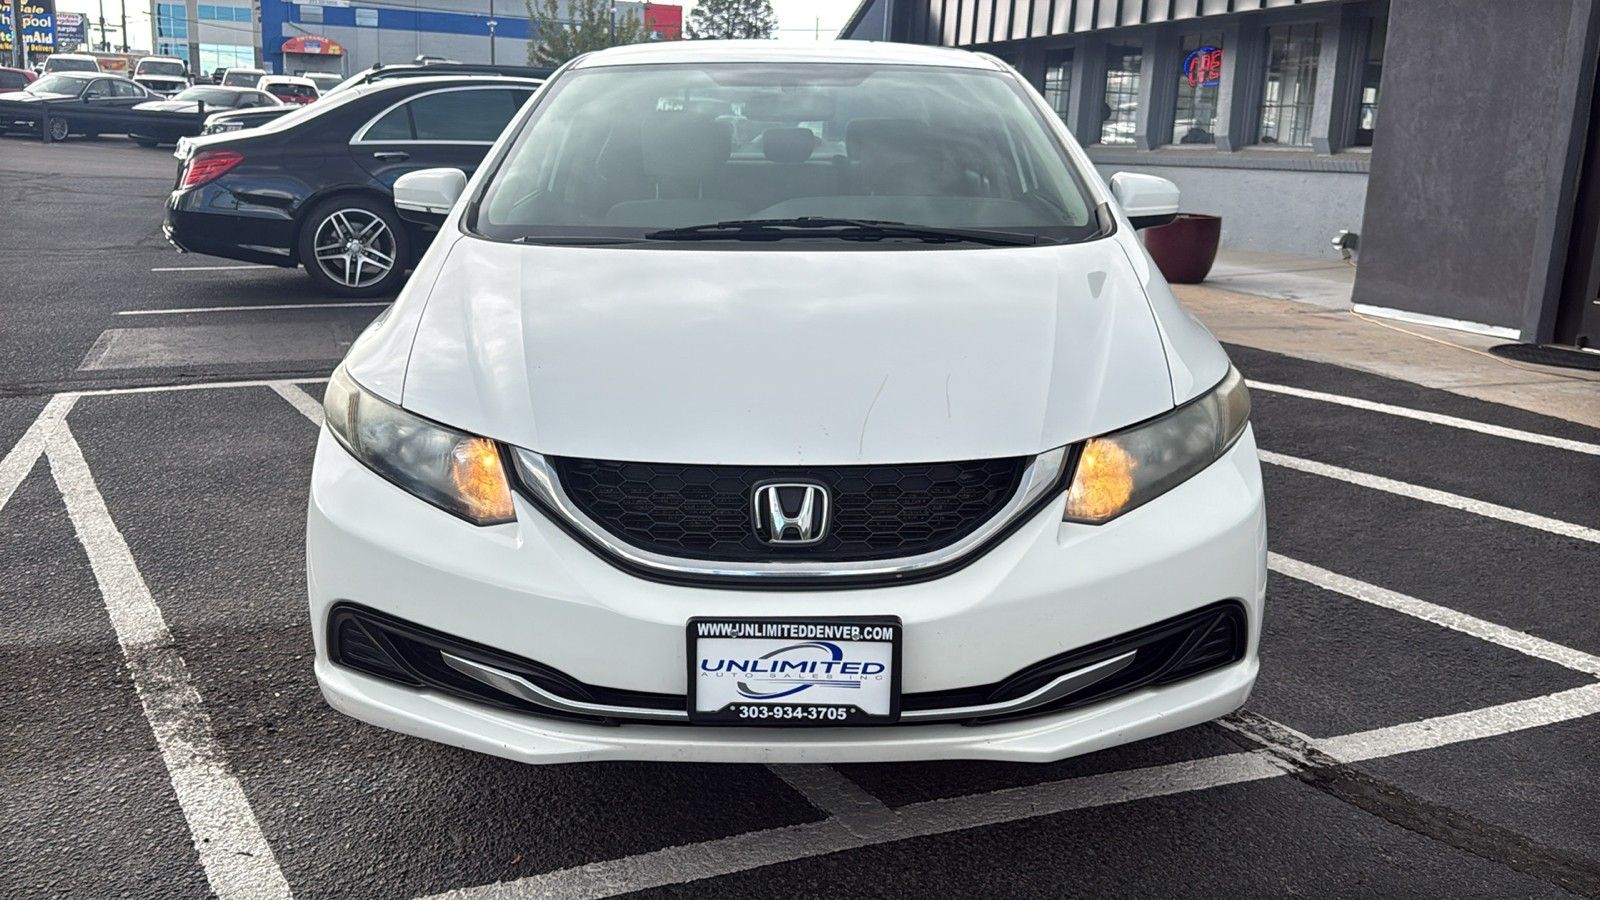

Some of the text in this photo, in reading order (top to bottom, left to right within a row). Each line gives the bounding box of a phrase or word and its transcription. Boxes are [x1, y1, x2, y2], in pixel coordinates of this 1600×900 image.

[697, 622, 893, 641] WWWUNLIMITEDDENVER.COM
[700, 658, 885, 675] UNLIMITED
[739, 705, 847, 720] 303-934-3705
